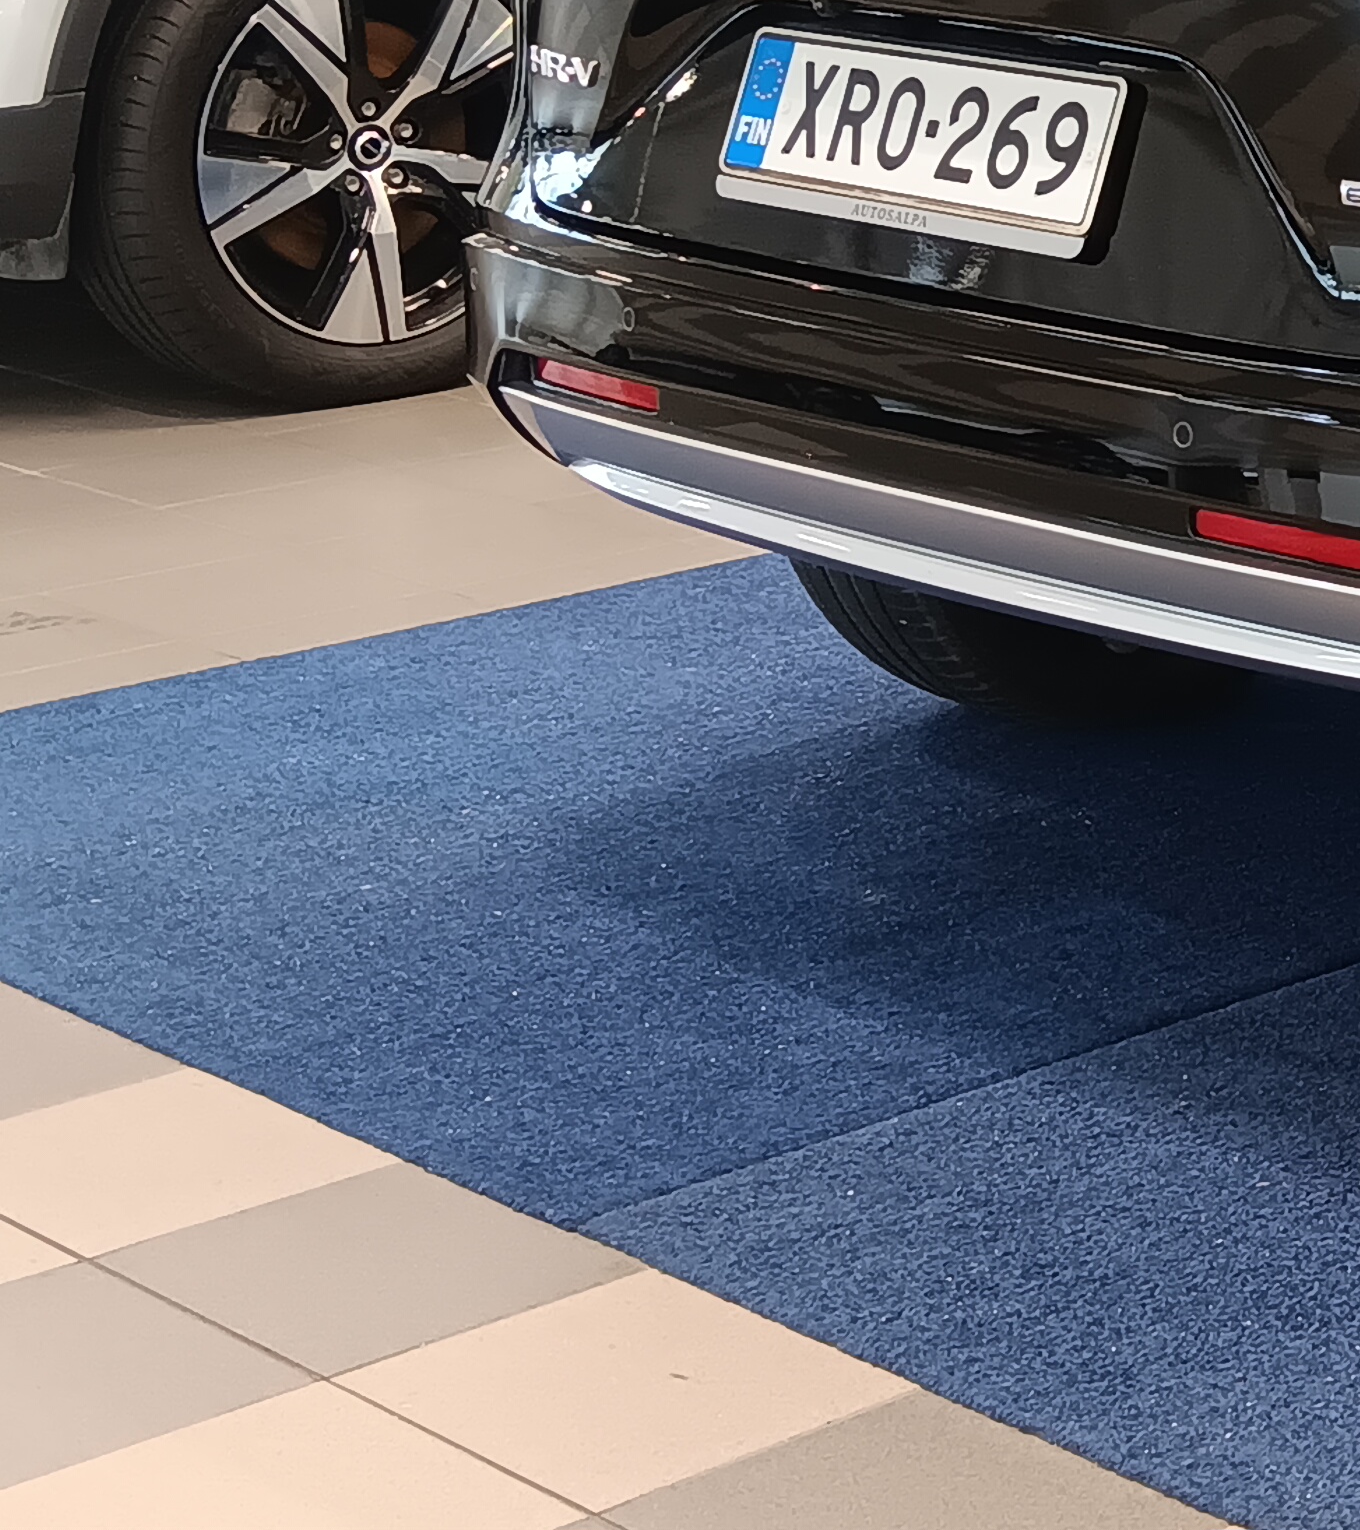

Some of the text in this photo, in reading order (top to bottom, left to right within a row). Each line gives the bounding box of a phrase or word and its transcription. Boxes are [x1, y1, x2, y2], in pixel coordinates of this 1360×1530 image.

[530, 44, 599, 87] HR-V
[735, 114, 773, 146] FIN
[851, 203, 927, 228] AUTOSALPA
